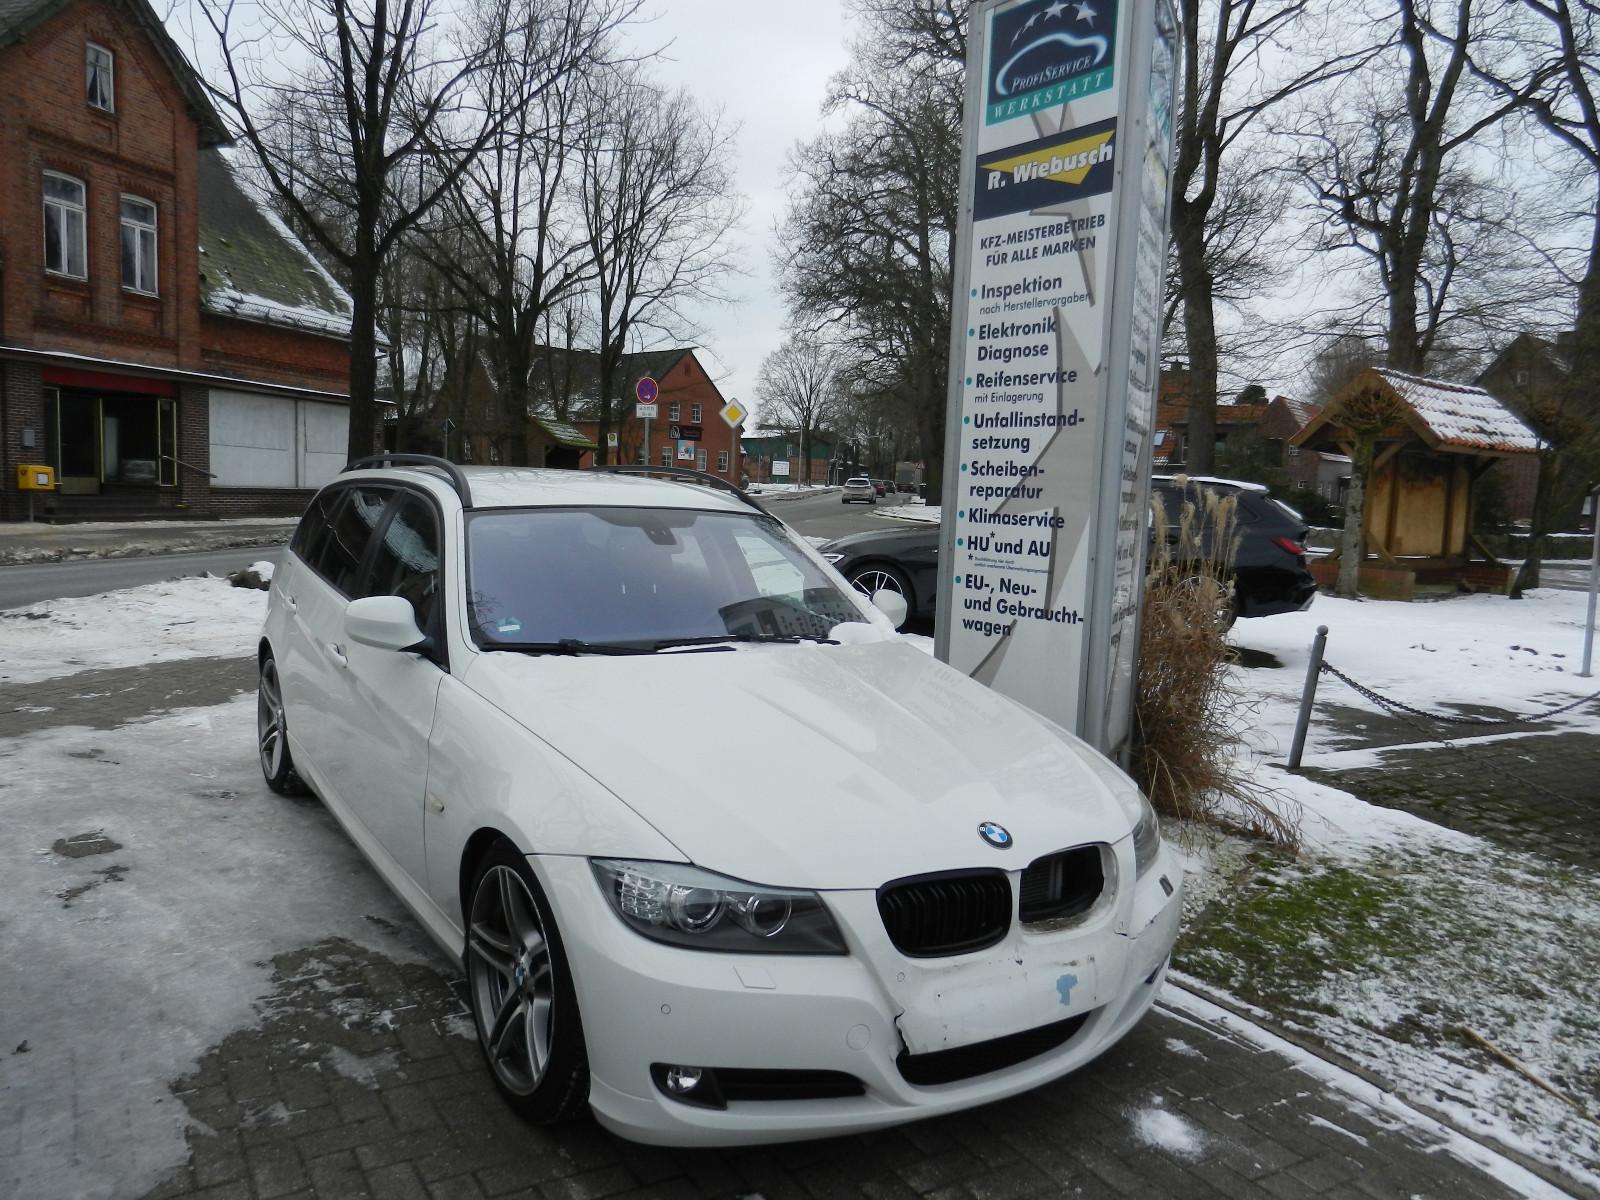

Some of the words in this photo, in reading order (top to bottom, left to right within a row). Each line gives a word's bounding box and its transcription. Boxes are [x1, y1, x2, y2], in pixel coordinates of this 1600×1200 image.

[994, 72, 1105, 119] WERKSTATT
[987, 171, 1006, 191] R.
[1013, 143, 1113, 185] Wiebusch
[980, 214, 1105, 250] KFZ-MEISTERBETRIEB
[986, 251, 1007, 267] FÜR
[1011, 247, 1038, 264] ALLE
[1042, 236, 1096, 258] MARKEN
[981, 275, 1062, 301] Inspektion
[979, 303, 1001, 315] nach
[978, 316, 1057, 341] Elektronik
[977, 343, 1049, 363] Diagnose
[975, 367, 1078, 388] Reifenservice
[975, 393, 989, 404] mit
[991, 391, 1044, 404] Einlagerung
[973, 409, 1085, 429] Unfallinstand-
[972, 435, 1031, 453] setzung
[970, 460, 1045, 477] Scheiben-
[969, 484, 1043, 501] reparatur
[968, 508, 1065, 529] Klimaservice
[994, 538, 1023, 555] und
[1027, 540, 1051, 557] AU
[965, 574, 995, 593] EU-,
[999, 578, 1037, 596] Neu-
[964, 597, 992, 612] und
[996, 599, 1084, 625] Gebraucht-
[962, 617, 1012, 637] wagen
